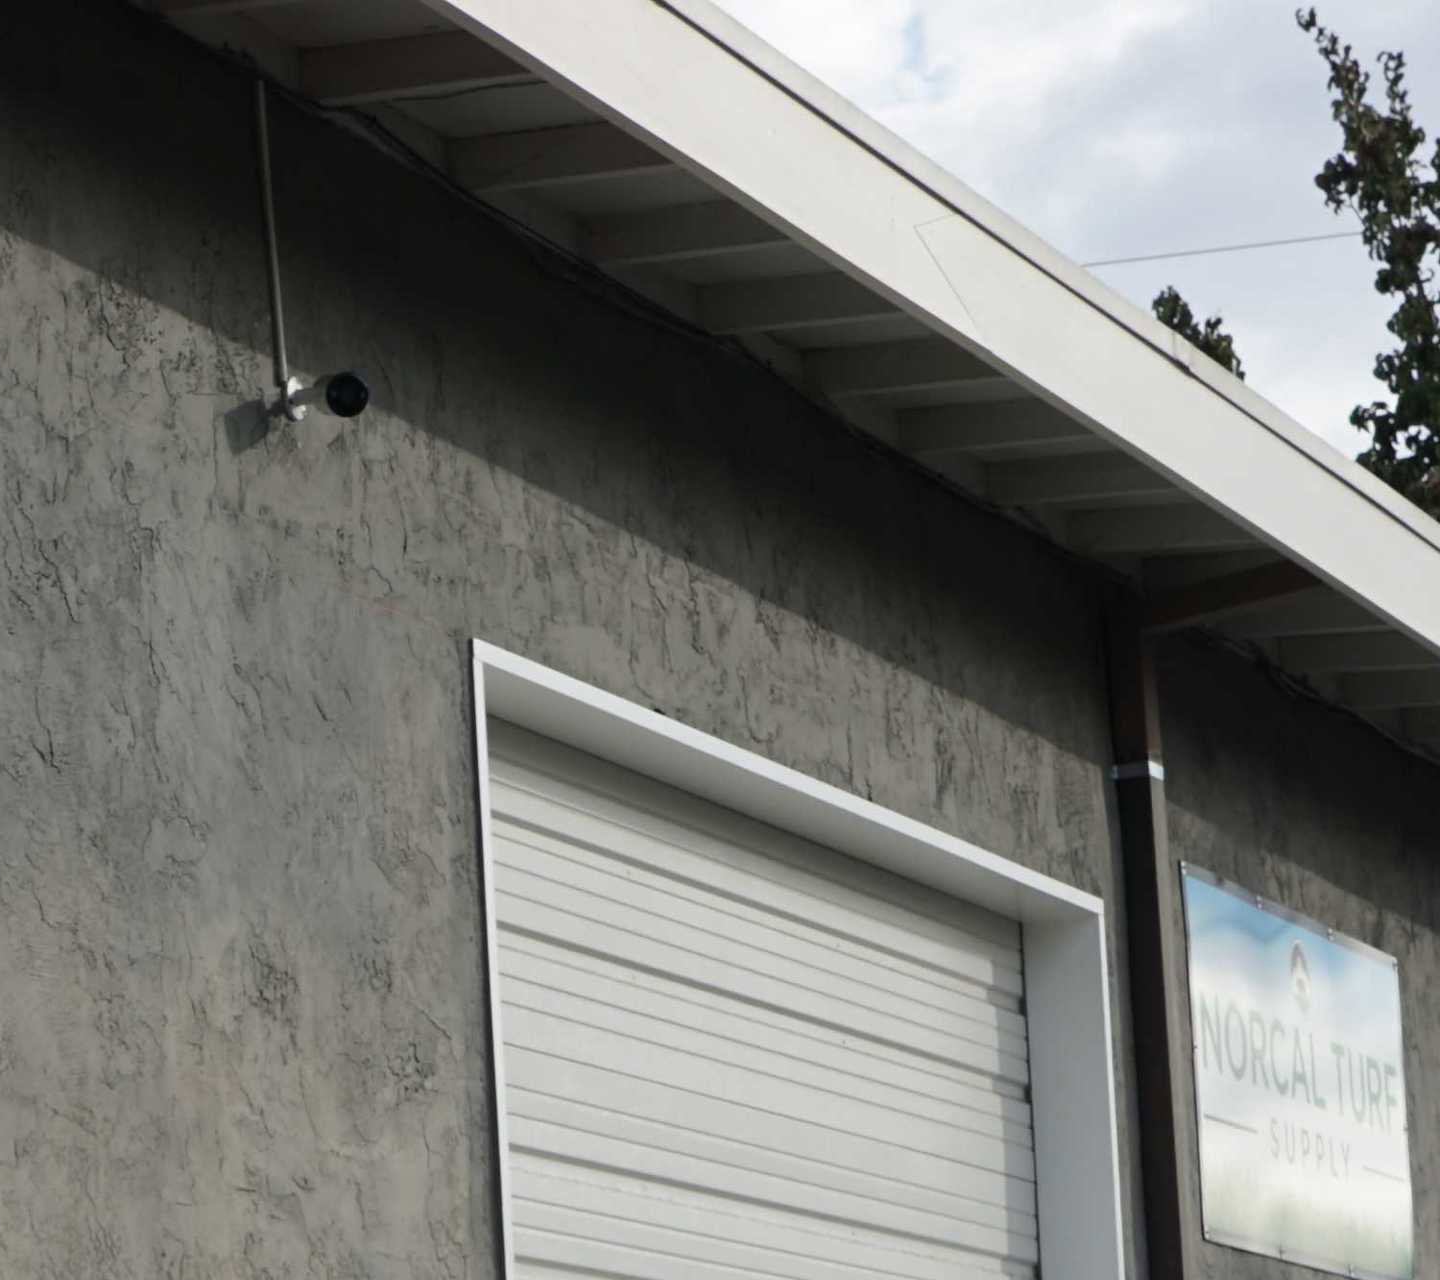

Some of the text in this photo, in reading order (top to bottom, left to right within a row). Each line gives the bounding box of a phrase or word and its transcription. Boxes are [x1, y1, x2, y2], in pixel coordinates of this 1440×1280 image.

[1199, 991, 1399, 1136] NORCAL TURF
[1269, 1117, 1351, 1183] SUPPLY
